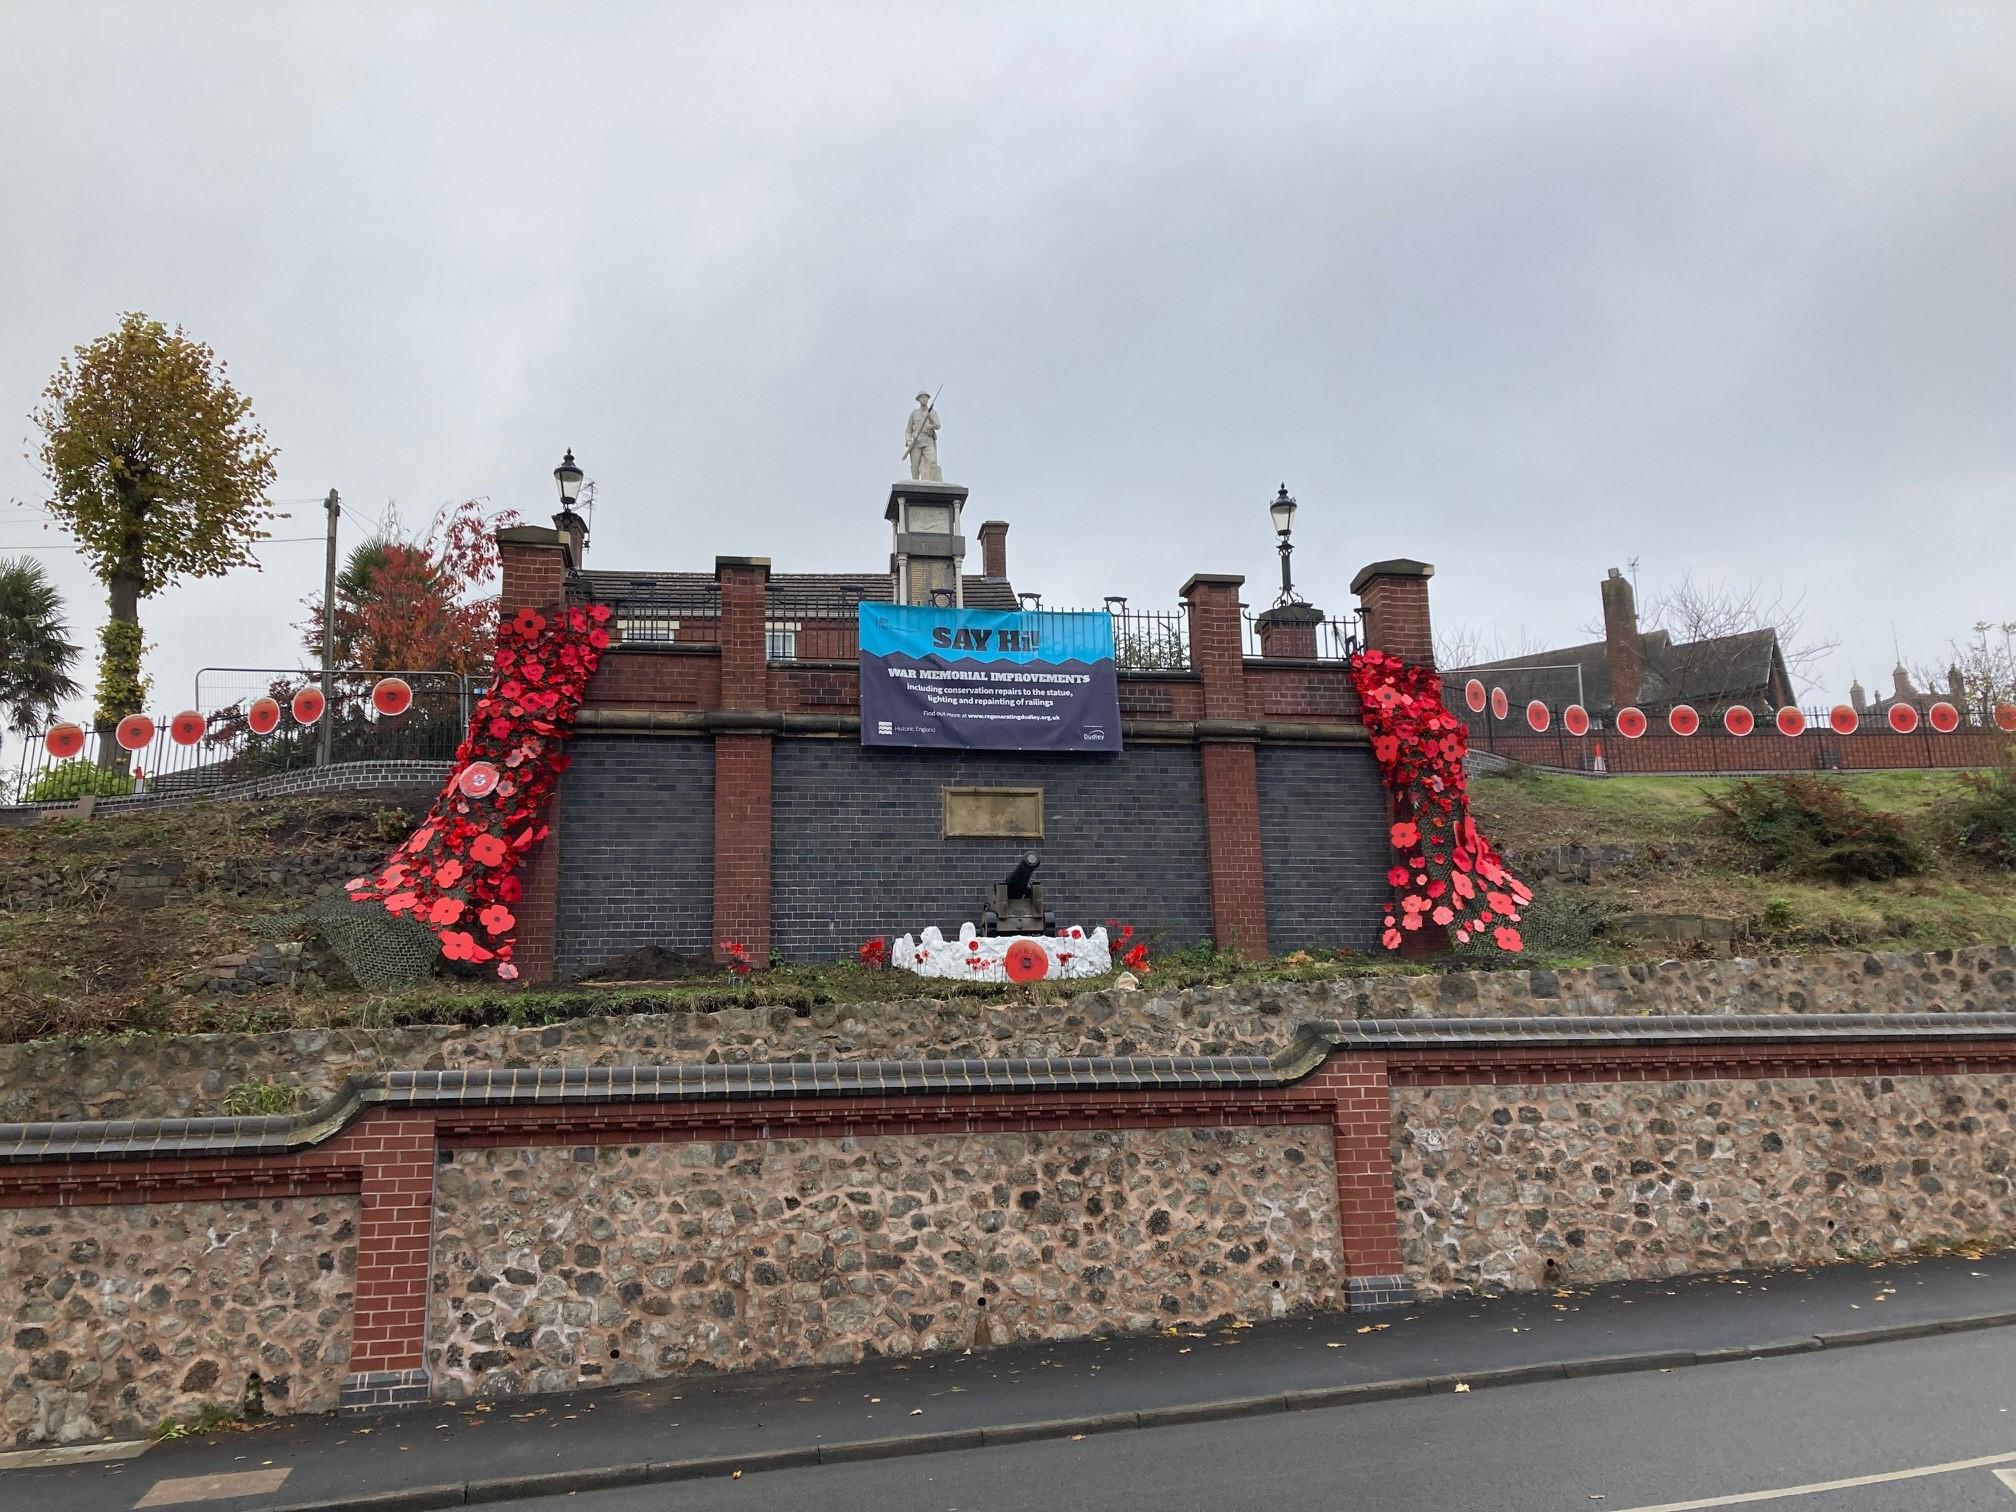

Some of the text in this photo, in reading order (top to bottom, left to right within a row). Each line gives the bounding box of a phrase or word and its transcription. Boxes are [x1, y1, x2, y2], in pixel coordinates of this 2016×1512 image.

[932, 627, 992, 651] SAY
[888, 668, 1090, 683] WAR MEMORIAL IMPROVEMENTS
[907, 683, 943, 694] Including
[995, 688, 1021, 696] repairs
[928, 695, 957, 705] lighting
[974, 698, 1015, 706] repainting
[1025, 699, 1053, 707] railings
